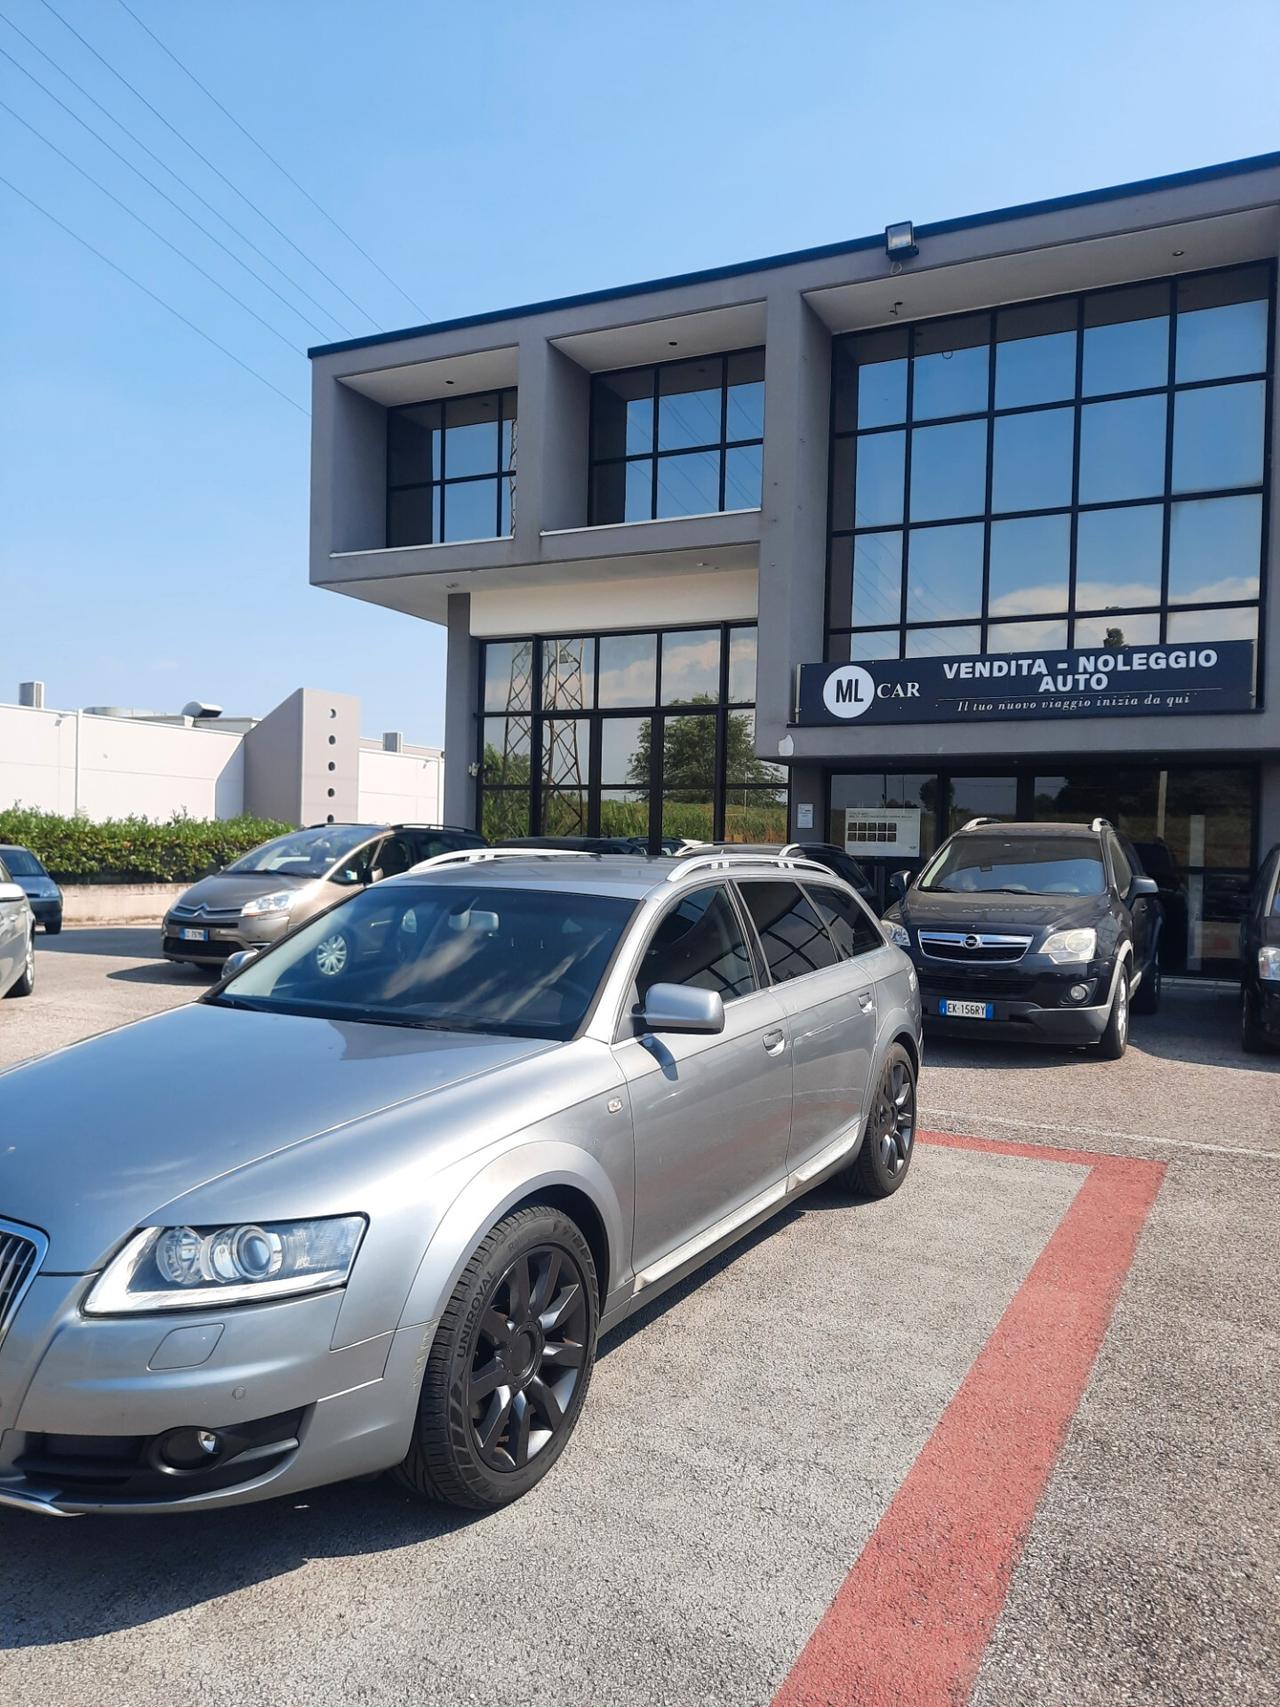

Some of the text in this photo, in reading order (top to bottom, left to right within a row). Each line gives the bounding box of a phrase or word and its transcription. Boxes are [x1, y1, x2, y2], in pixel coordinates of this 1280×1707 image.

[942, 658, 1049, 679] VENDITA
[1078, 649, 1218, 673] NOLEGGIO
[835, 678, 864, 703] ML
[877, 682, 920, 699] CAR
[1038, 673, 1109, 692] AUTO
[957, 692, 1191, 712] Il tuo nuovo viaggio inizia da qui
[456, 1270, 496, 1358] UNIROYAL
